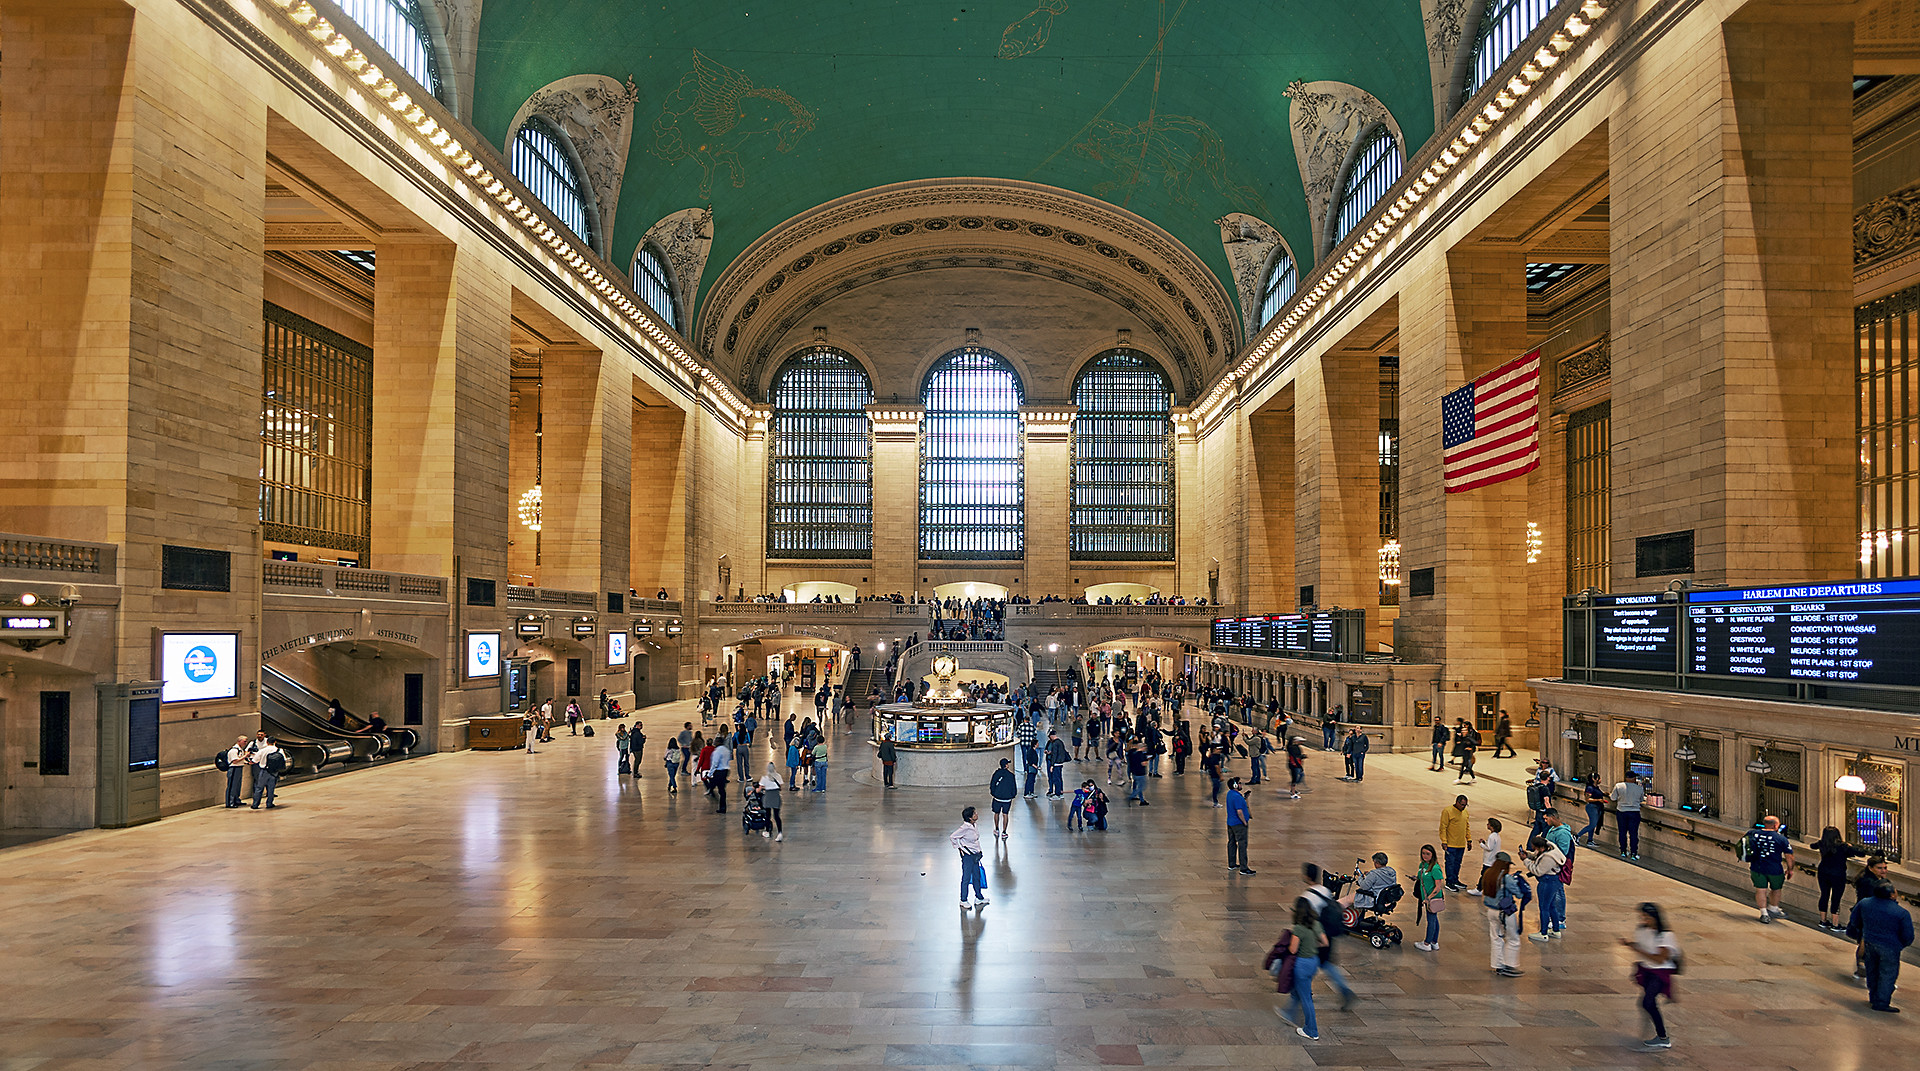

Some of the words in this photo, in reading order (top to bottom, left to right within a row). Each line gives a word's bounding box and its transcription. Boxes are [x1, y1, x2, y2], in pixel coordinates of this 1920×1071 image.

[1743, 589, 1782, 600] HARLEM
[1783, 587, 1807, 598] LINE
[1809, 583, 1882, 597] DEPARTURES
[1615, 595, 1657, 605] INFORMATION
[377, 629, 394, 638] 45TH
[395, 631, 418, 644] STREET
[795, 630, 826, 638] LEXINGTON
[1100, 632, 1128, 641] LEXINGTON
[261, 646, 279, 661] THE
[280, 634, 316, 653] METLIFE
[317, 628, 354, 642] BUILDING
